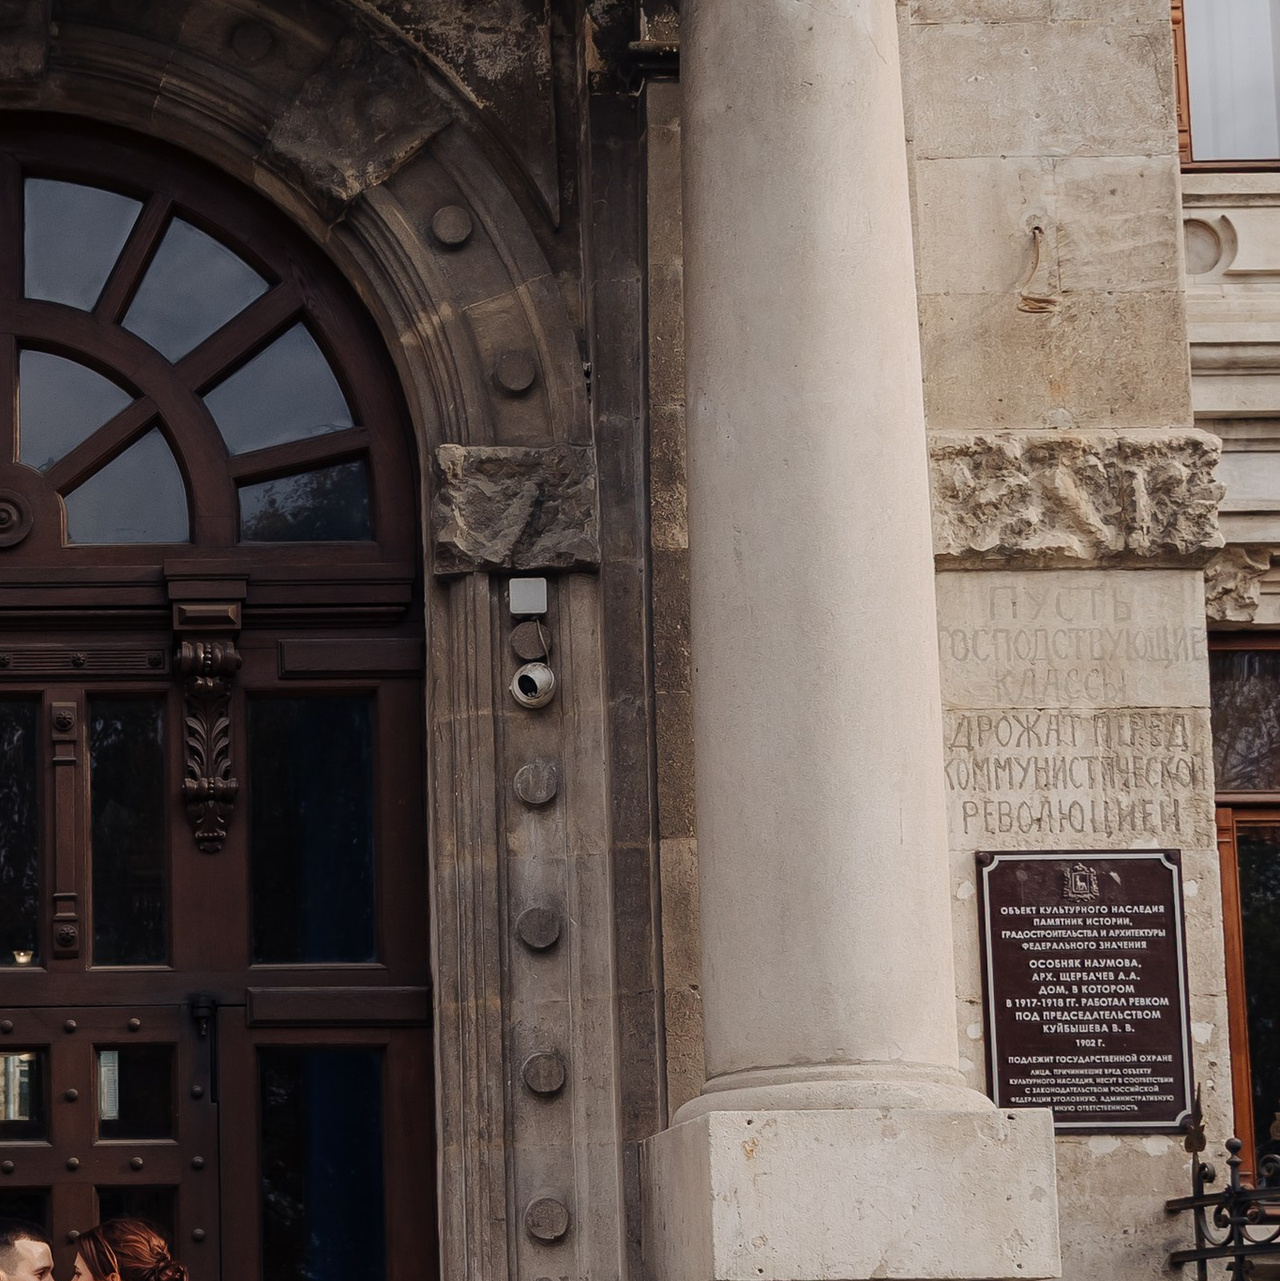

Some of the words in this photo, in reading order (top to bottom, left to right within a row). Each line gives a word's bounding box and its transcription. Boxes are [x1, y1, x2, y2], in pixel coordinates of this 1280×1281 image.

[948, 712, 1079, 751] ДРОЖАТ
[1000, 905, 1036, 915] ОБЪЕКТ
[1040, 905, 1108, 914] КУЛЬТУРНОГО
[1111, 904, 1164, 914] НАСЛЕДИЯ
[1033, 917, 1084, 926] ПАМЯТНИК
[1086, 917, 1133, 926] ИСТОРИИ,
[1002, 929, 1099, 939] ГРАДОСТРОИТЕЛЬСТВА
[1100, 929, 1107, 938] И
[1108, 928, 1166, 938] АРХИТЕКТУРЫ
[1022, 941, 1096, 951] ФЕДЕРАЛЬНОГО
[1099, 941, 1147, 950] ЗНАЧЕНИЯ
[1029, 959, 1081, 969] ОСОБНЯК
[1084, 959, 1142, 969] НАУМОВА,
[1032, 972, 1056, 982] АРХ.
[1060, 972, 1114, 982] ЩЕРБАЧЕВ
[1118, 972, 1140, 982] А.А.
[1038, 985, 1069, 995] ДОМ,
[1072, 985, 1078, 995] В
[1081, 985, 1135, 995] КОТОРОМ
[1006, 998, 1012, 1008] В
[1015, 997, 1064, 1008] 1917-1918
[1066, 997, 1079, 1007] ГГ.
[1081, 997, 1127, 1007] РАБОТАЛ
[1128, 997, 1170, 1007] РЕВКОМ
[1015, 1011, 1040, 1021] ПОД
[1042, 1010, 1161, 1021] ПРЕДСЕДАТЕЛЬСТВОМ
[1043, 1023, 1109, 1033] КУЙБЫШЕВА
[1112, 1023, 1122, 1033] В.
[1125, 1023, 1135, 1033] В.
[1076, 1039, 1096, 1047] 1902
[1098, 1039, 1105, 1047] Г.
[1008, 1053, 1054, 1064] ПОДЛЕЖИТ
[1056, 1053, 1137, 1064] ГОСУДАРСТВЕННОЙ
[1139, 1053, 1172, 1063] ОХРАНЕ
[1122, 1067, 1152, 1075] ОБЪЕКТУ
[1009, 1077, 1056, 1085] КУЛЬТУРНОГО
[1123, 1076, 1174, 1084] СООТВЕТСТВИИ
[1024, 1086, 1030, 1094] С
[1032, 1085, 1109, 1093] ЗАКОНОДАТЕЛЬСТВОМ
[1110, 1085, 1159, 1093] РОССИЙСКОЙ
[1010, 1095, 1051, 1103] ФЕДЕРАЦИИ
[1100, 1094, 1174, 1102] АДМИНИСТРАТИВНУЮ
[1054, 1104, 1075, 1112] ИНУЮ
[1076, 1104, 1138, 1112] ОТВЕТСТВЕННОСТЬ
